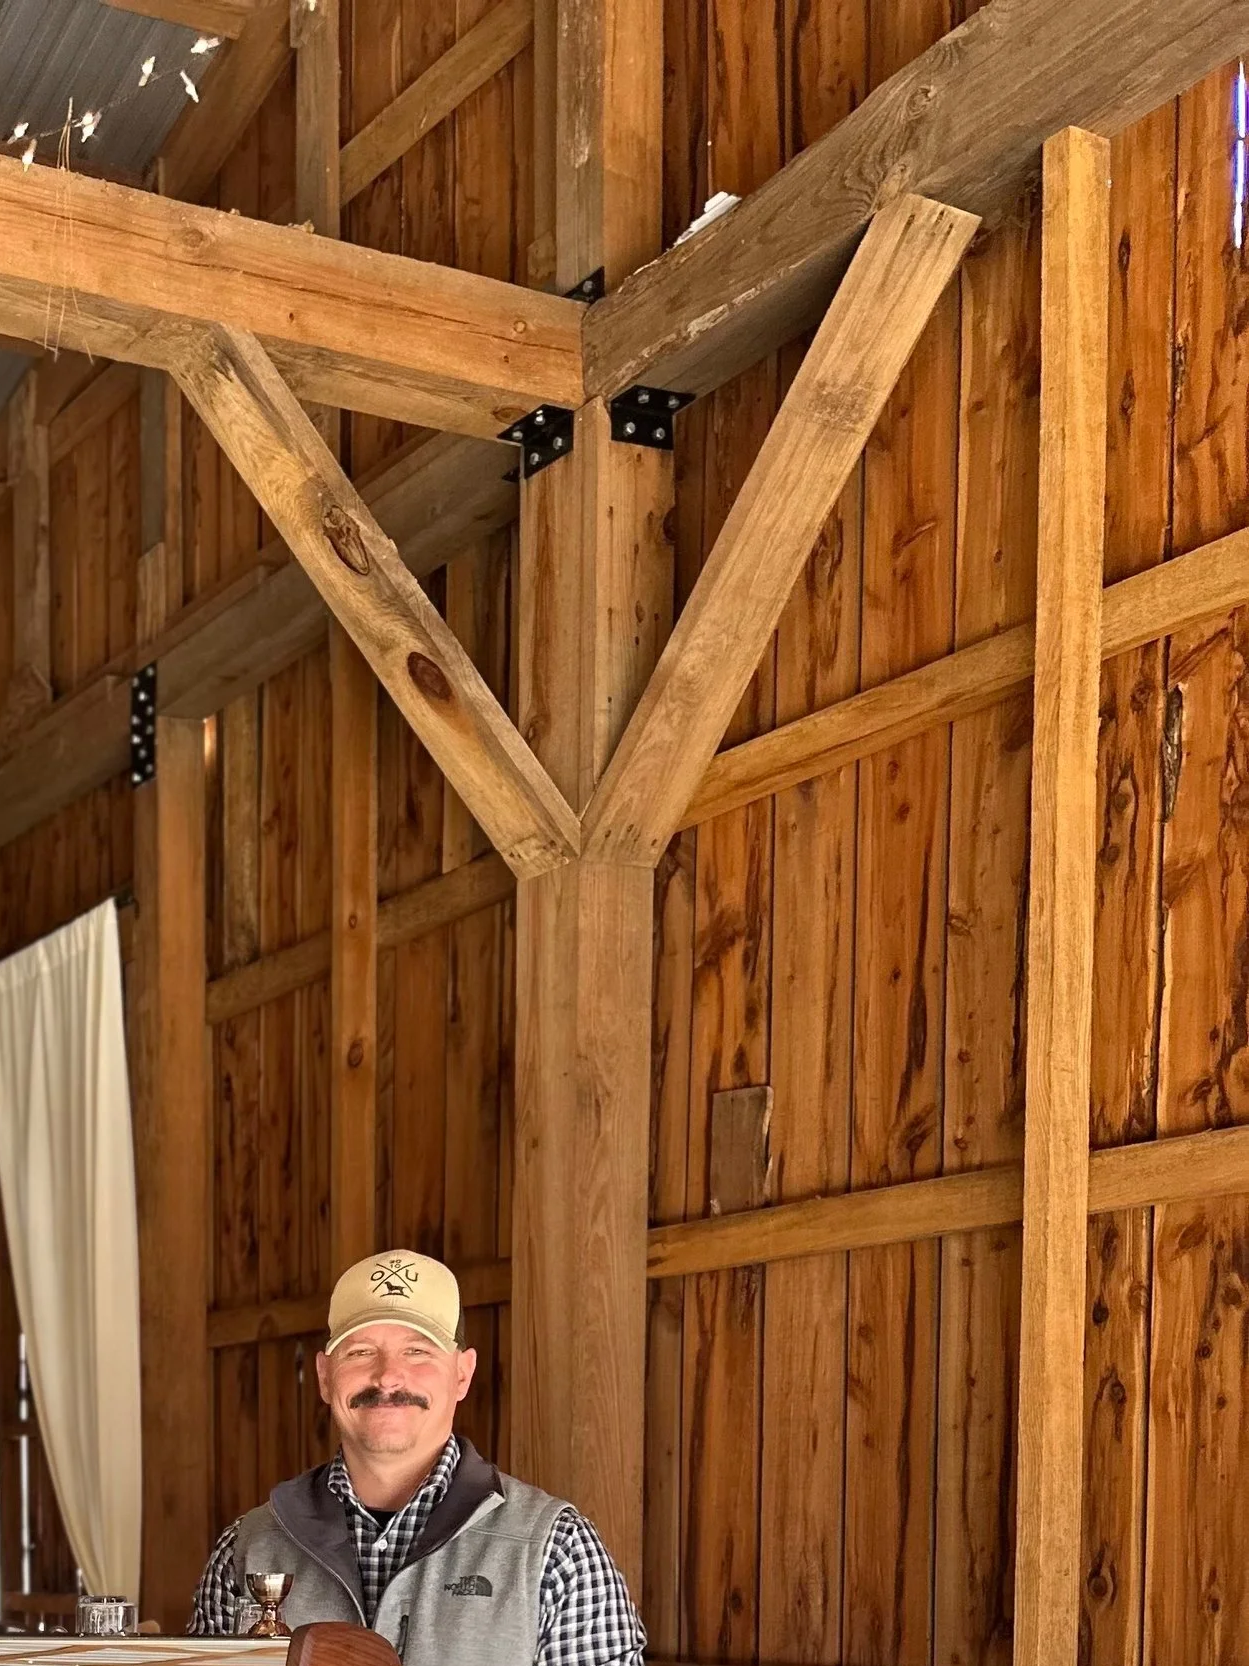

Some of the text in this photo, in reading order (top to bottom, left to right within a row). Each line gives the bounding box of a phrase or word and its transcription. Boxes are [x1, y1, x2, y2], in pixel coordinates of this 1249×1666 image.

[370, 1268, 419, 1282] O U
[459, 1575, 476, 1584] THE
[443, 1582, 475, 1591] NORTH
[452, 1589, 476, 1597] FACE
